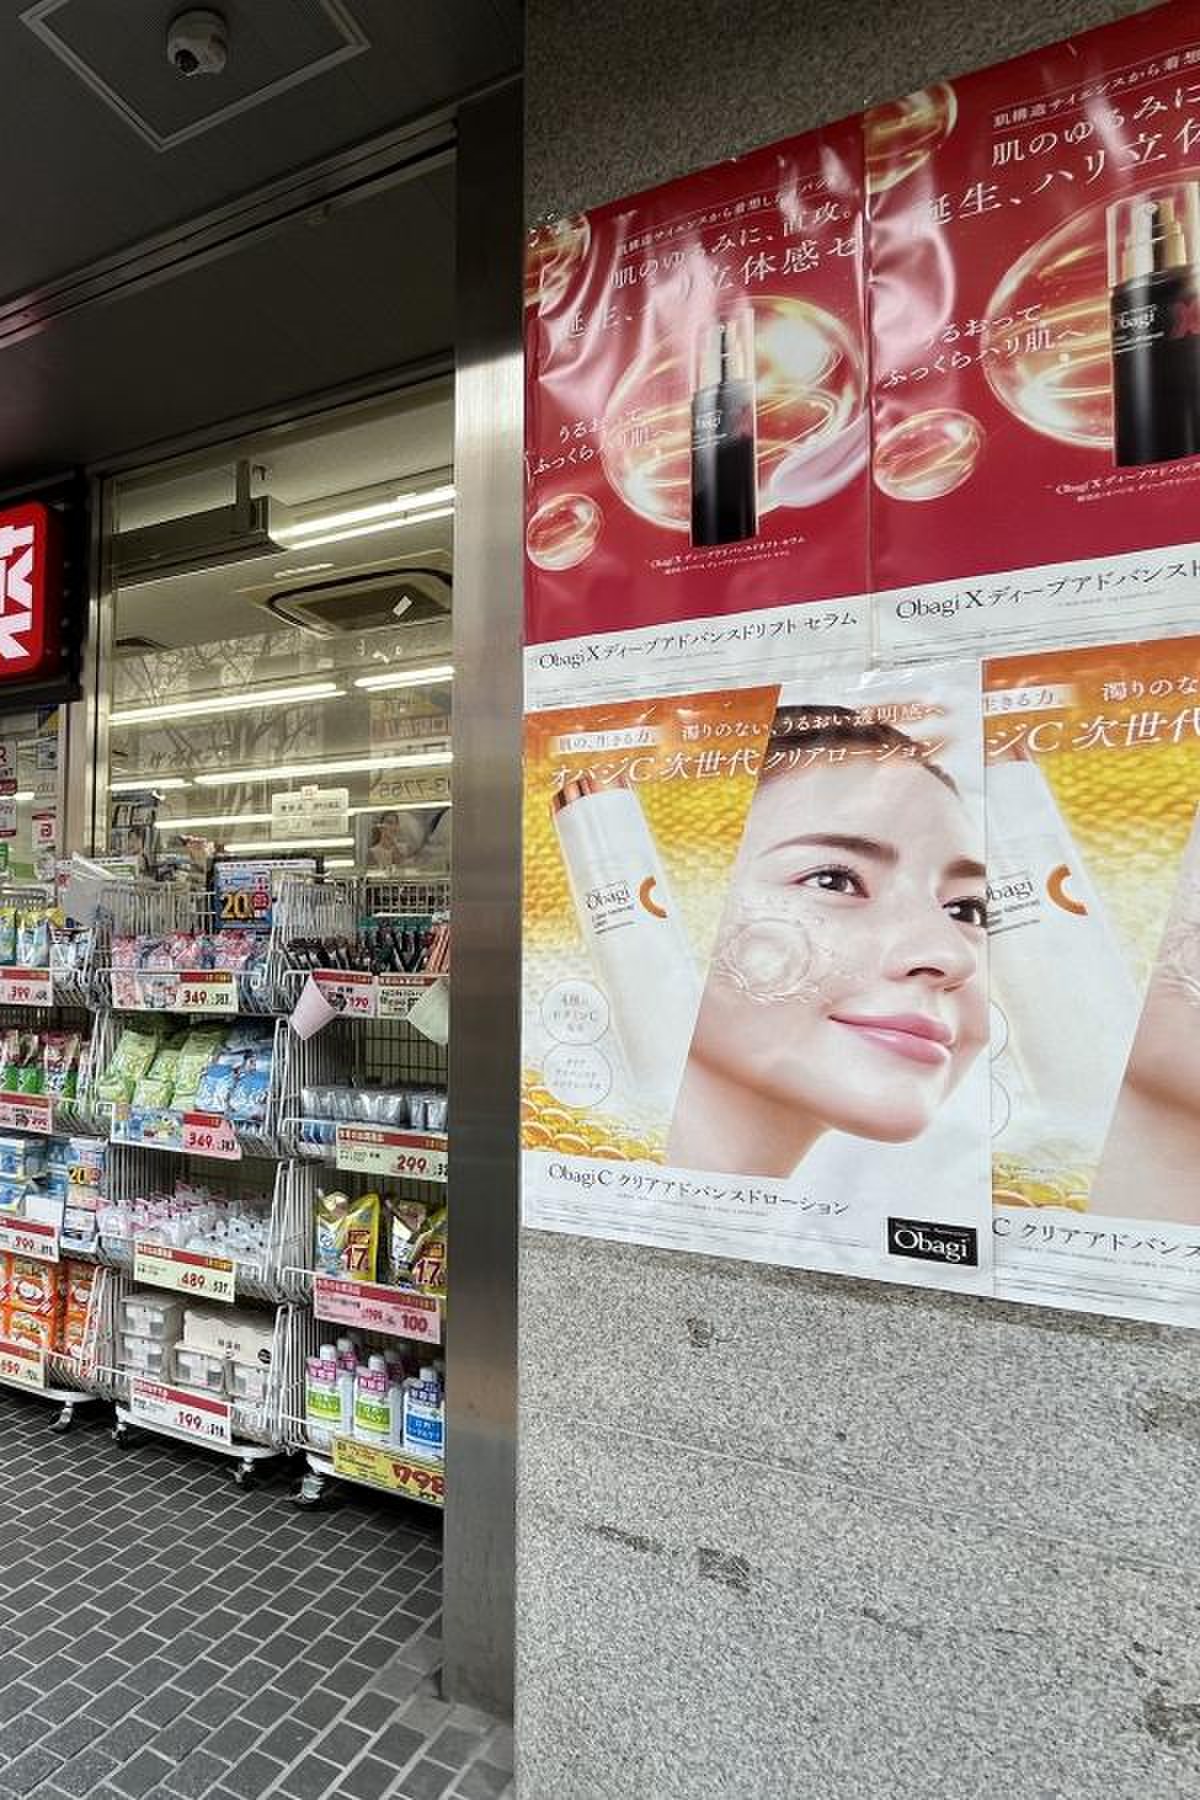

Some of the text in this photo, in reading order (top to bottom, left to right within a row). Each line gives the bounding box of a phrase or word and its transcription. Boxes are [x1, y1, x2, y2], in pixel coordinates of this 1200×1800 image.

[396, 1154, 428, 1174] 299
[894, 1230, 968, 1263] Obagi
[180, 1271, 205, 1288] 489
[178, 1410, 202, 1430] 199
